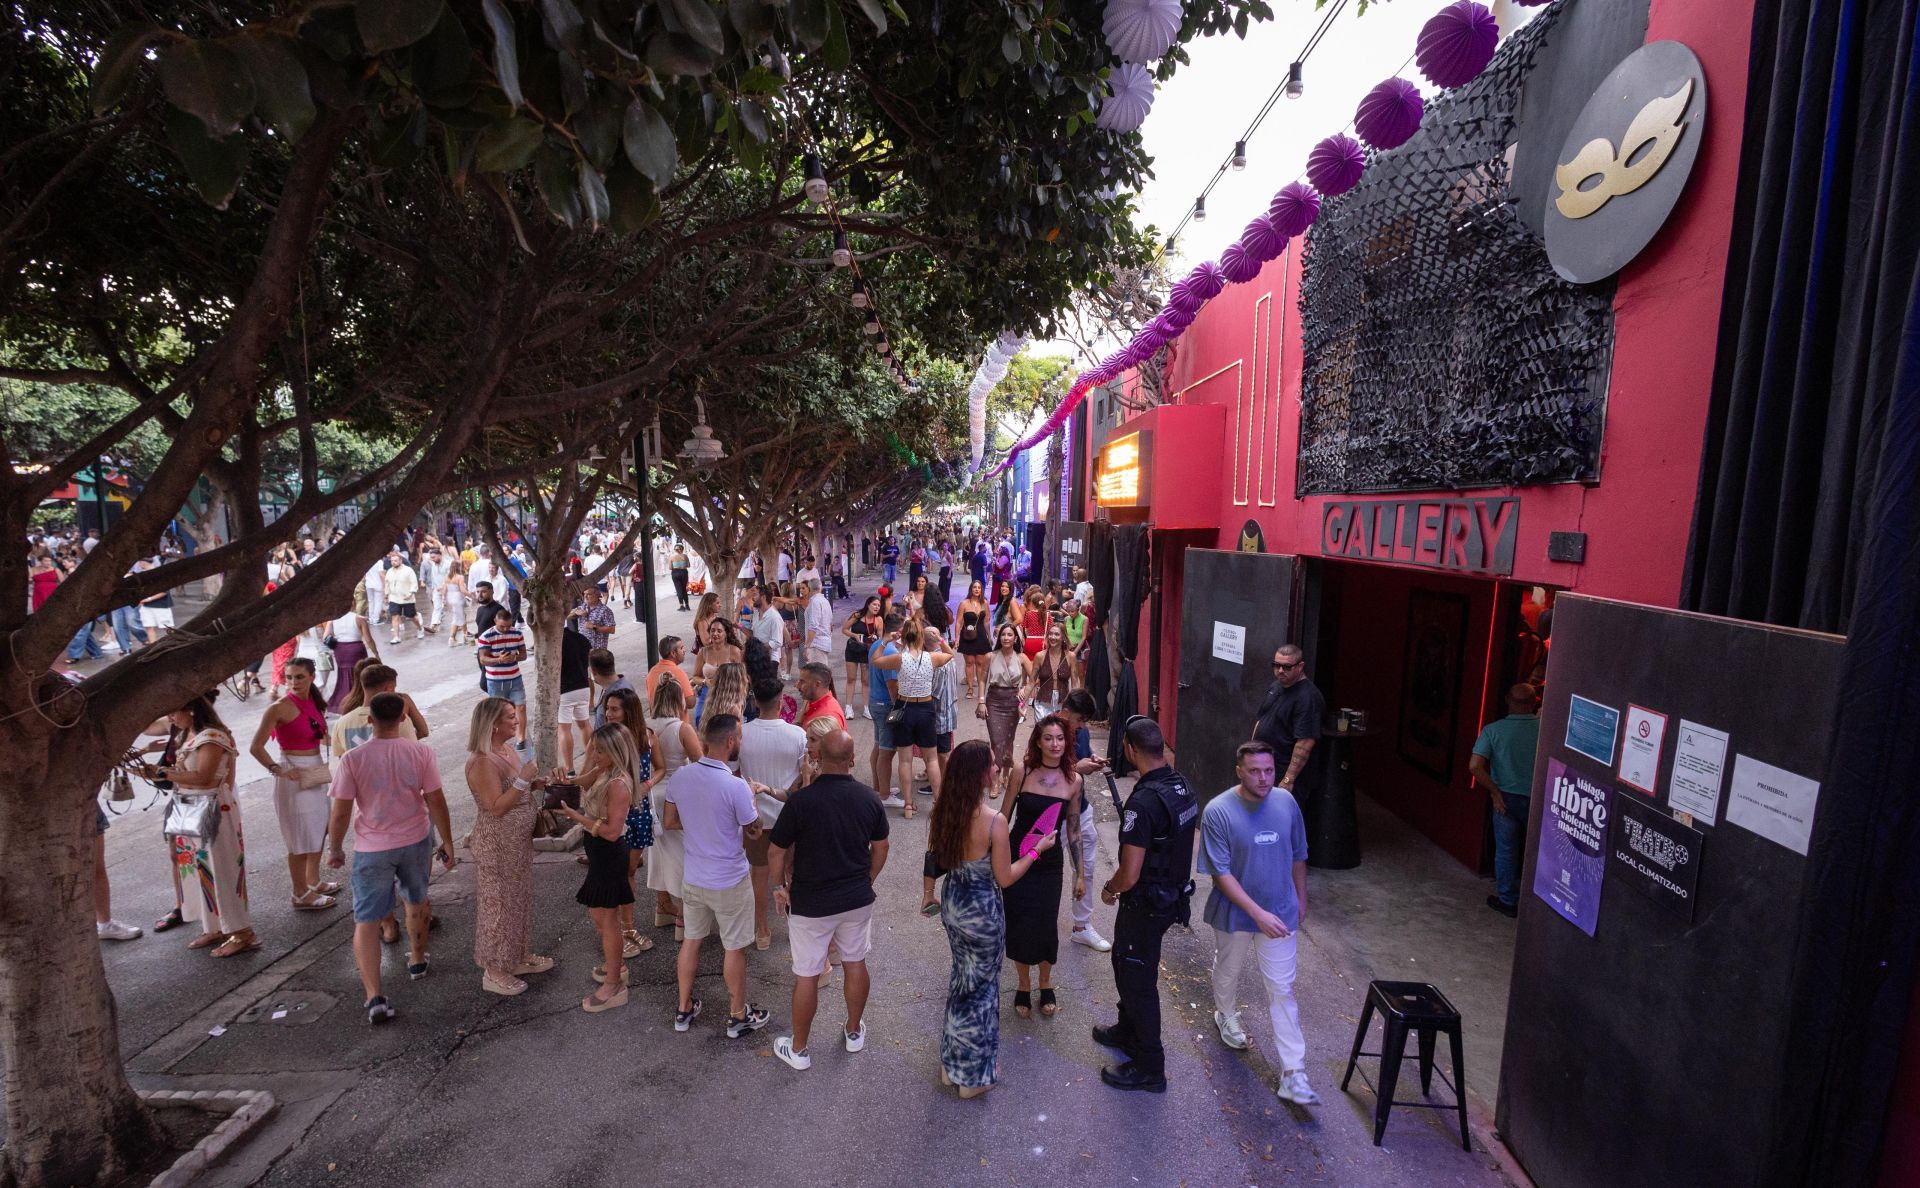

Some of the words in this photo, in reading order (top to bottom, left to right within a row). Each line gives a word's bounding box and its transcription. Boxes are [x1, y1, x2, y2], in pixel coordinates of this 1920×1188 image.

[1324, 501, 1514, 568] GALLERY
[1552, 776, 1607, 828] libre
[1577, 777, 1605, 802] Málaga
[1757, 781, 1788, 799] PROHIBIDA
[1551, 804, 1559, 815] de
[1561, 810, 1601, 839] violencias
[1558, 820, 1599, 850] machistas
[1624, 815, 1688, 864] TEATRO
[1616, 850, 1637, 869] LOCAL
[1638, 864, 1688, 898] CLIMATIZADO
